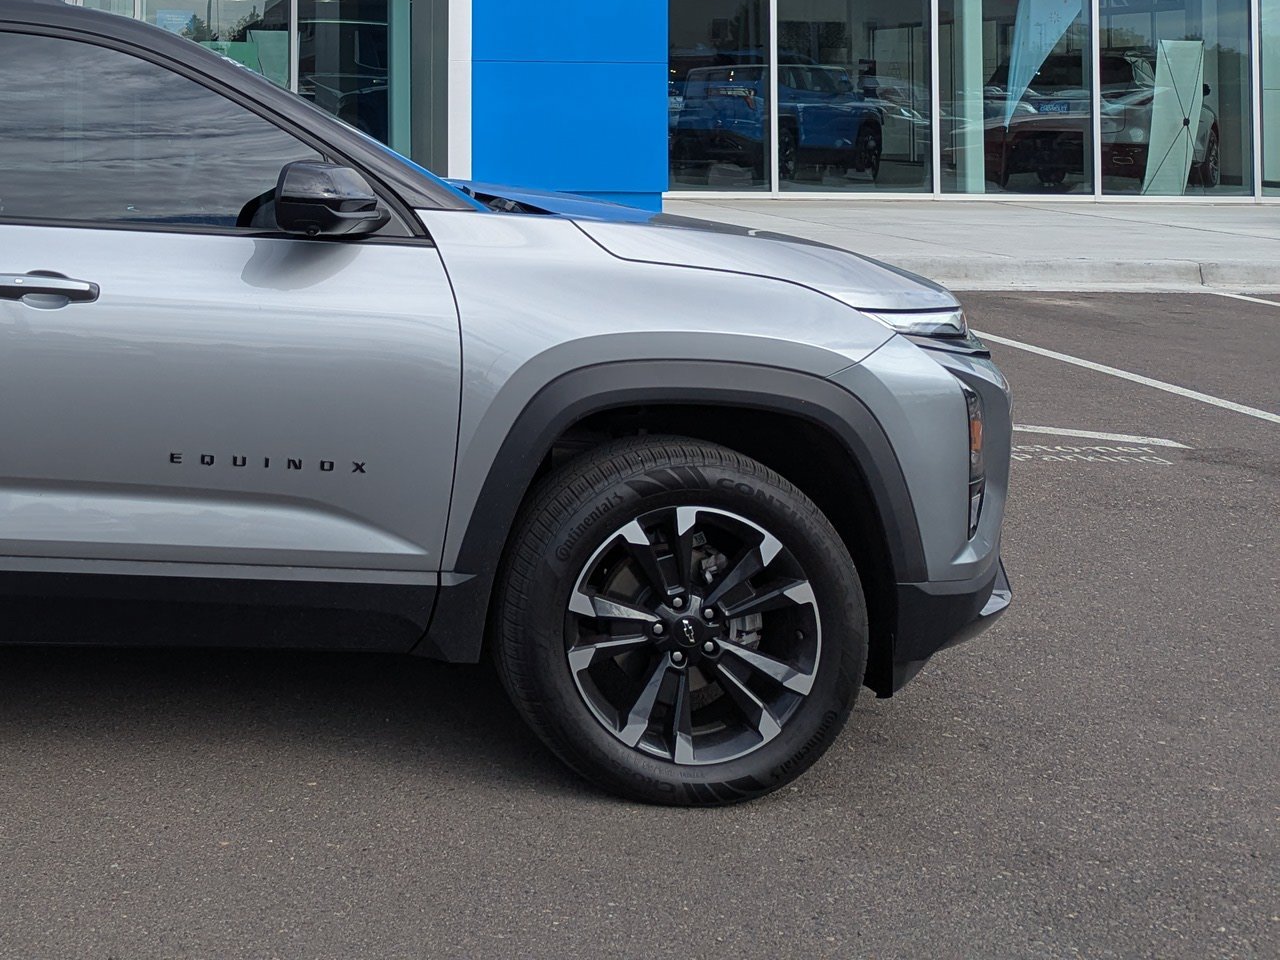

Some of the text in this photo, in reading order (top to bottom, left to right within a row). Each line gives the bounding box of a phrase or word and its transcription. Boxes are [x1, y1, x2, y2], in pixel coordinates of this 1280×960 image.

[1011, 444, 1156, 454] stomer
[170, 452, 367, 474] EQUINOX
[556, 497, 615, 561] Continental
